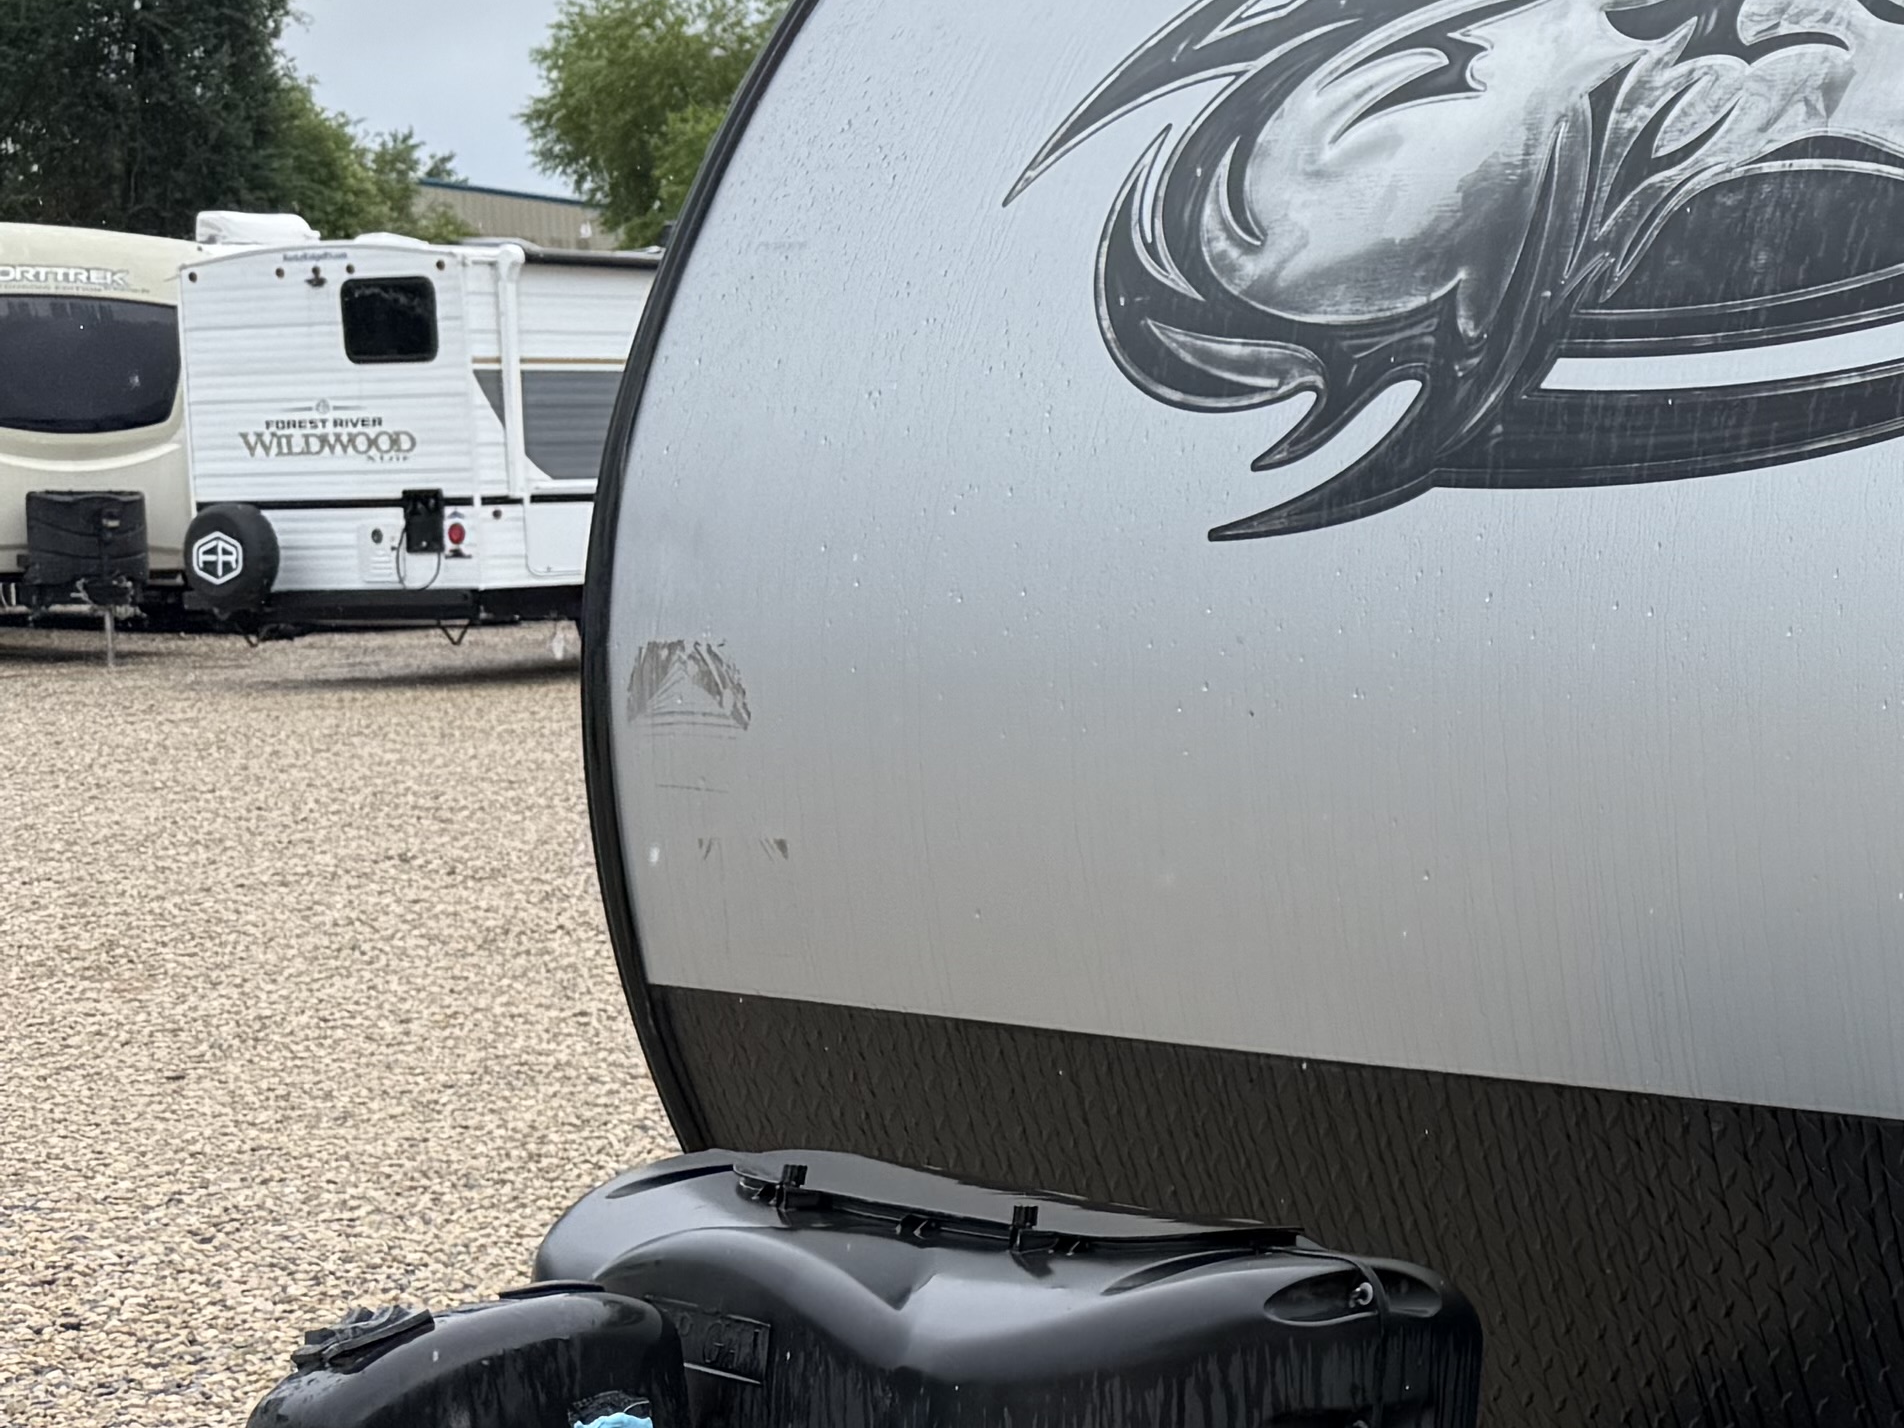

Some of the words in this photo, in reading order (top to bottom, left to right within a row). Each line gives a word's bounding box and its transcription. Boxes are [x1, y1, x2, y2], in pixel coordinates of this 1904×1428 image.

[265, 418, 328, 430] FOREST
[333, 417, 383, 429] RIVER
[238, 431, 417, 458] WILDWOOD
